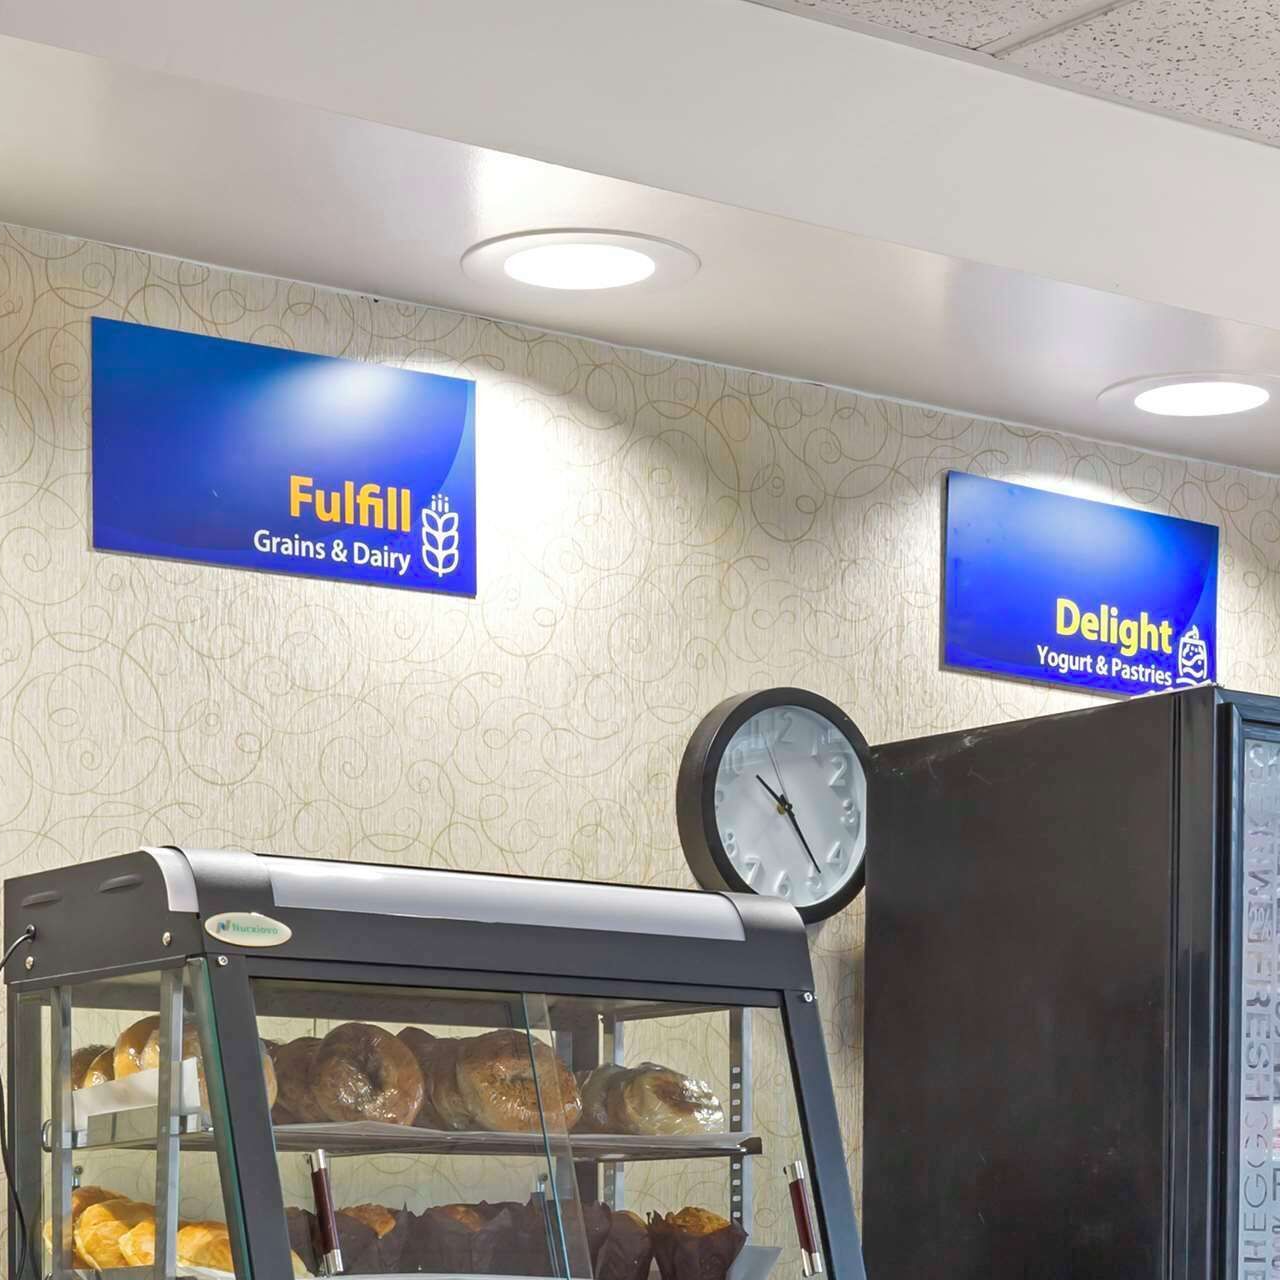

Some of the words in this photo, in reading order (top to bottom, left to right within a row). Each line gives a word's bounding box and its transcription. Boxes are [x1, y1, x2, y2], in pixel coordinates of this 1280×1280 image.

[290, 475, 411, 532] Fulfill
[254, 529, 325, 559] Grains
[331, 541, 348, 562] &
[353, 542, 410, 575] Dairy
[1056, 598, 1172, 656] Delight
[1037, 645, 1093, 675] Yogurt
[1095, 656, 1108, 676] &
[1111, 660, 1172, 686] Pastries
[829, 756, 846, 787] 2
